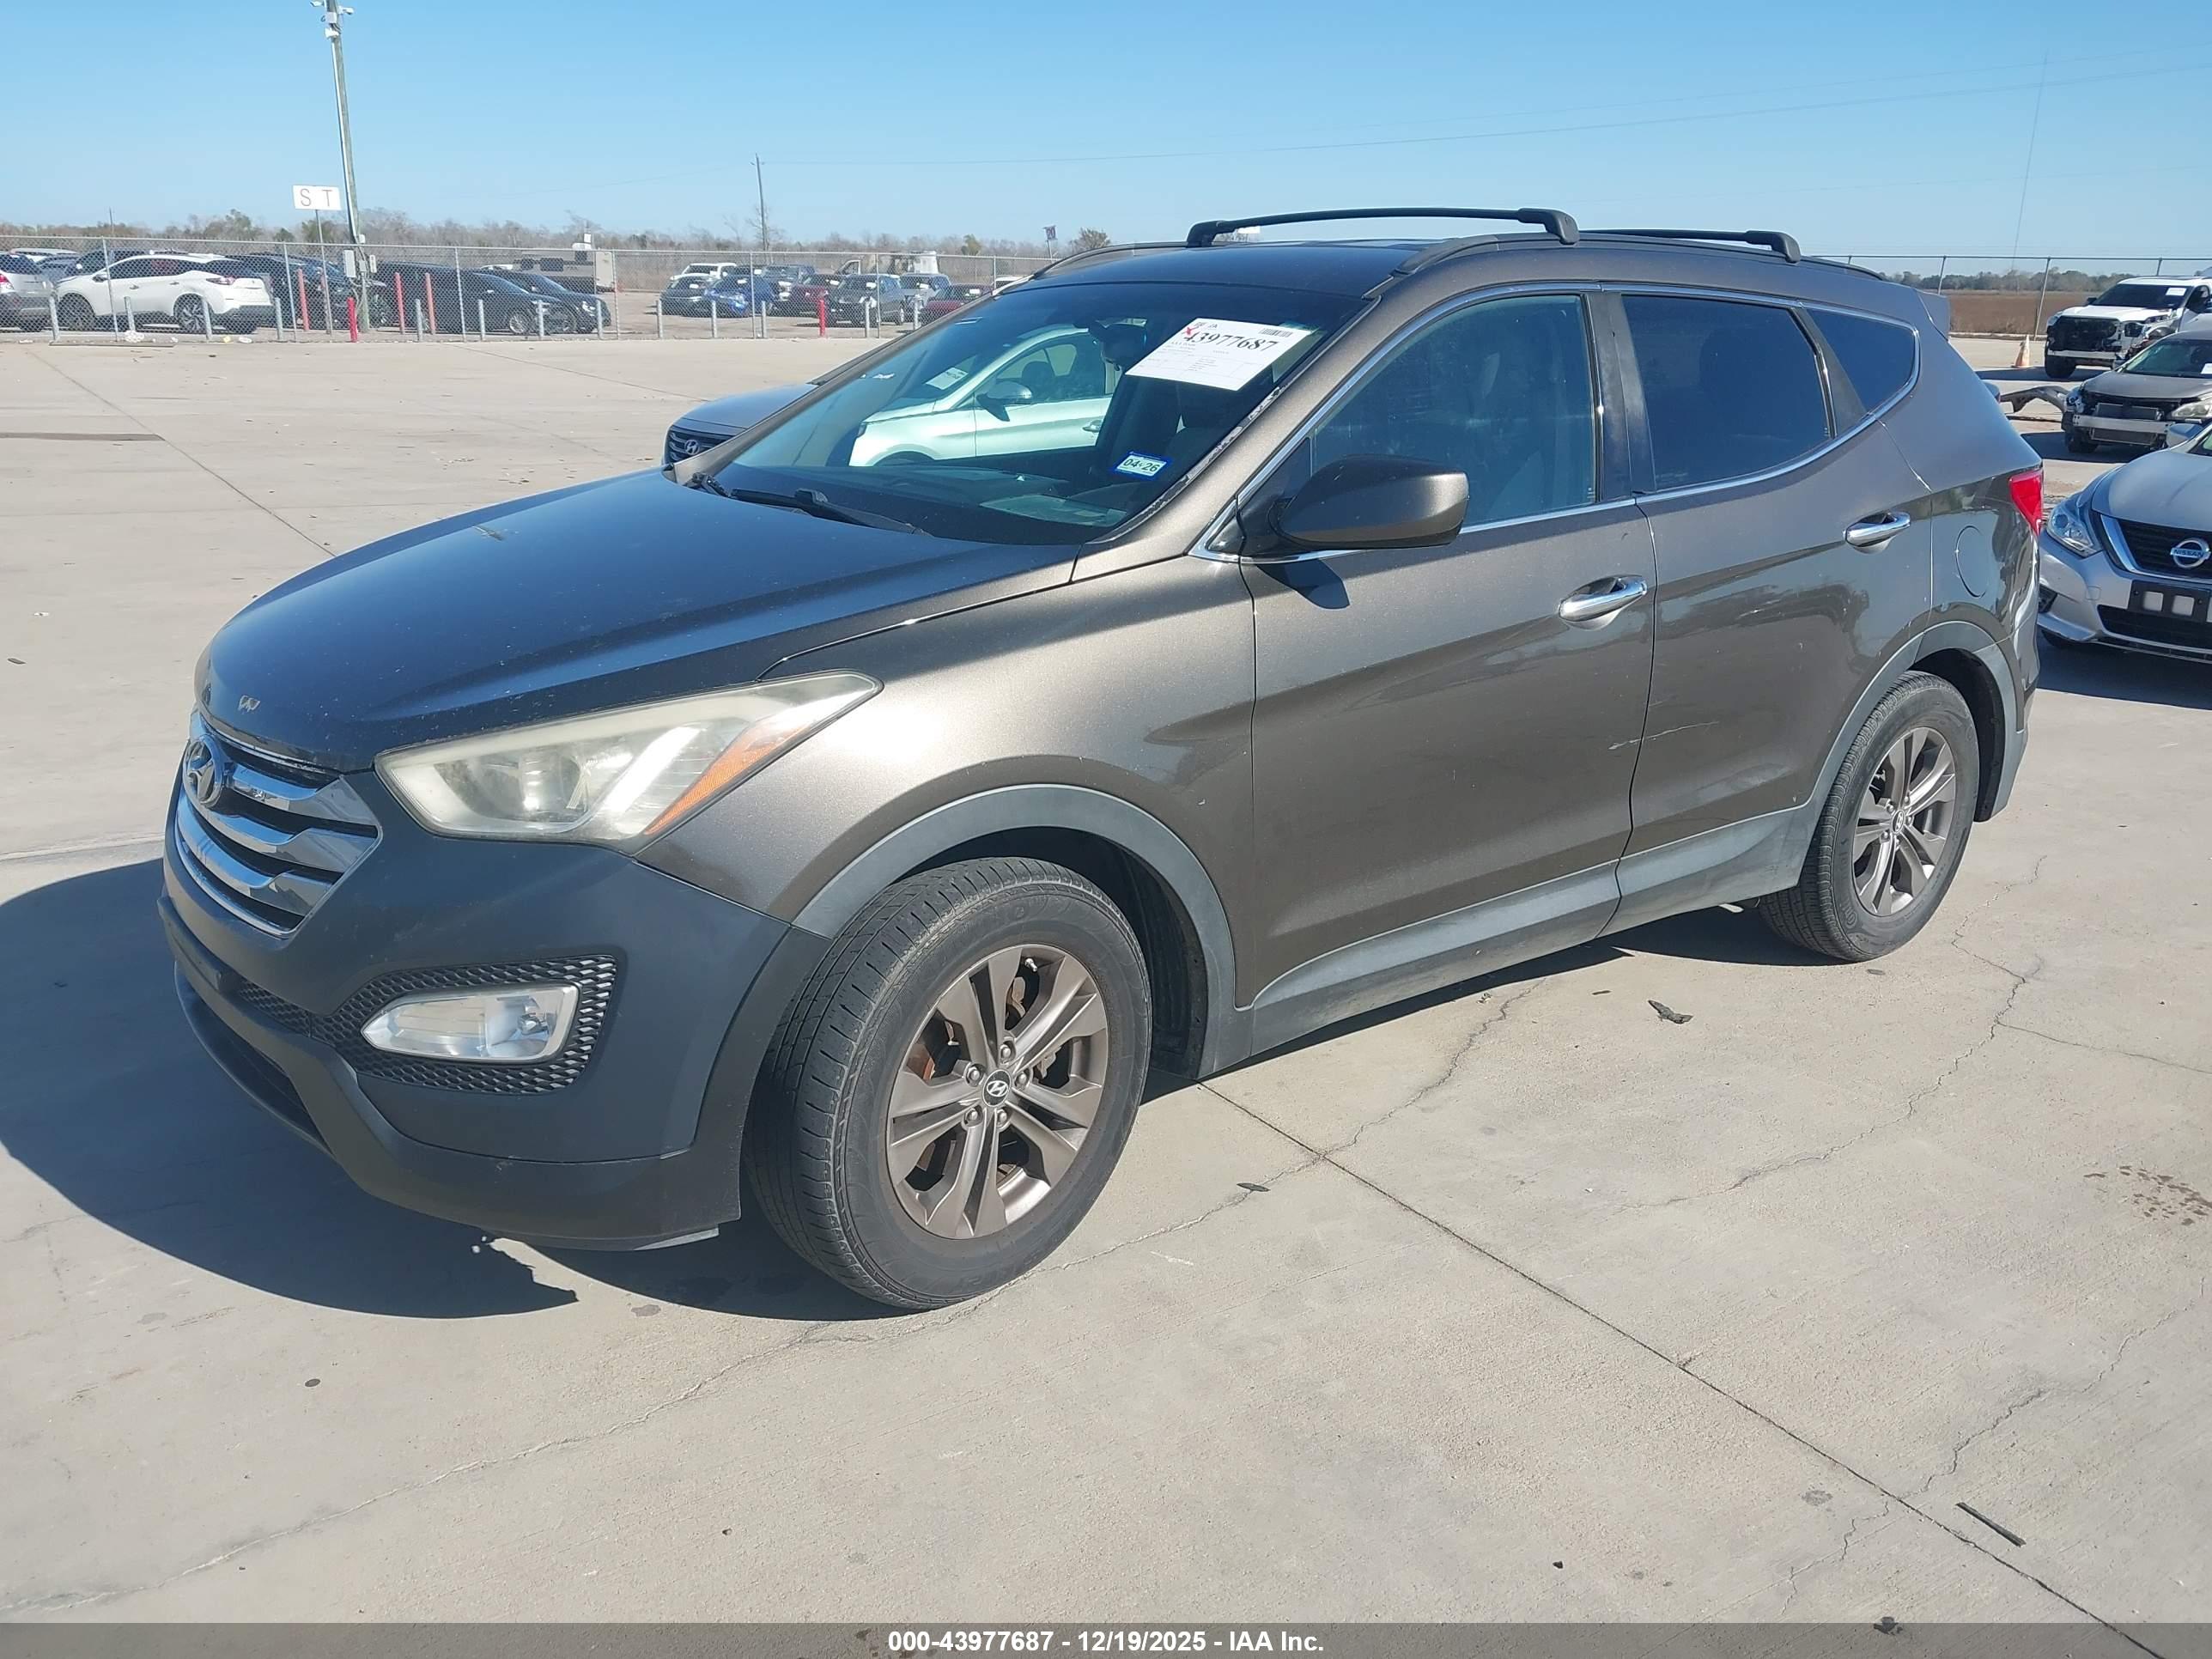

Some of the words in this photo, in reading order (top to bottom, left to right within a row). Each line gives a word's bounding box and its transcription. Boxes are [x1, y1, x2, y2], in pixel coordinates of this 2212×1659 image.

[301, 188, 312, 207] S
[321, 189, 333, 207] T
[1184, 331, 1279, 351] 43977687
[1141, 462, 1160, 472] 26
